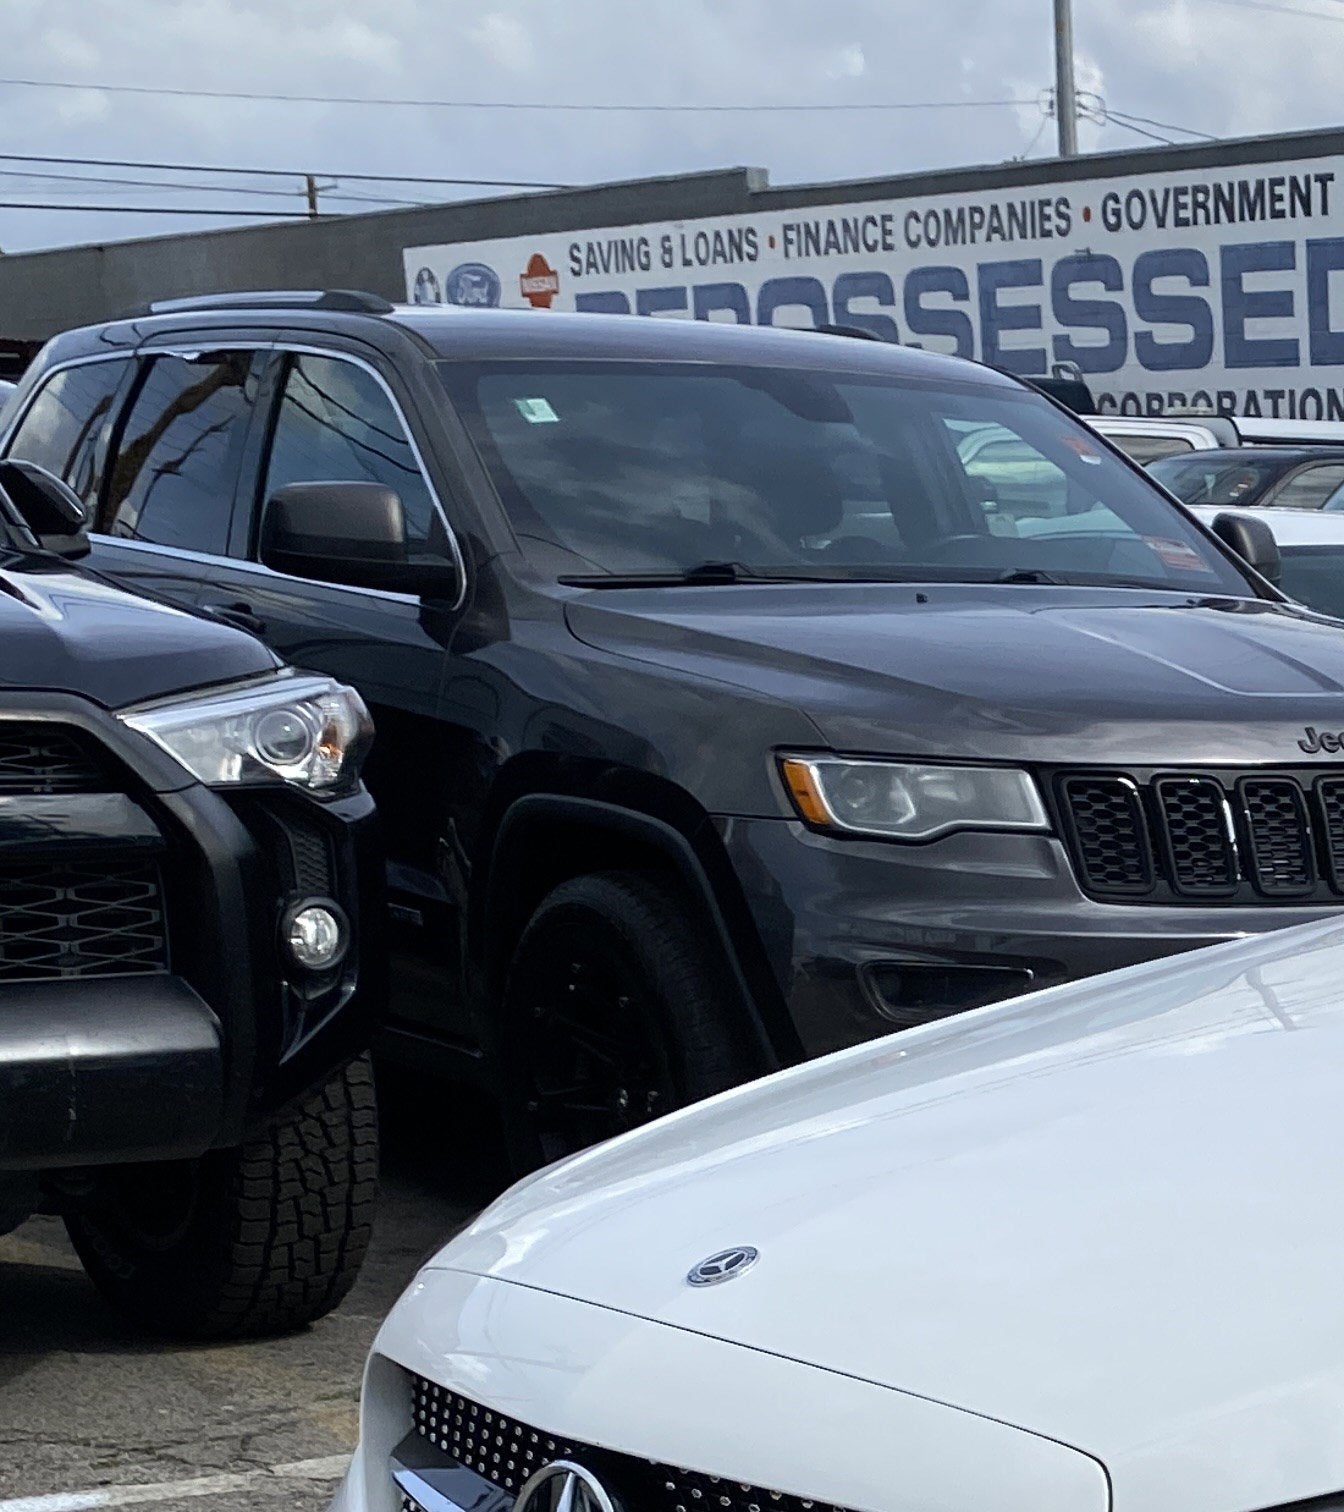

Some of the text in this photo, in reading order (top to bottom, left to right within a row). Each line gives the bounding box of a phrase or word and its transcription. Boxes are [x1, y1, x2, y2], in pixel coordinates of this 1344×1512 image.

[569, 239, 651, 277] SAVING
[660, 235, 673, 268] &
[682, 227, 759, 266] LOANS
[782, 214, 895, 259] FINANCE
[904, 197, 1073, 249] COMPANIES
[1101, 173, 1334, 232] GOVERNMENT
